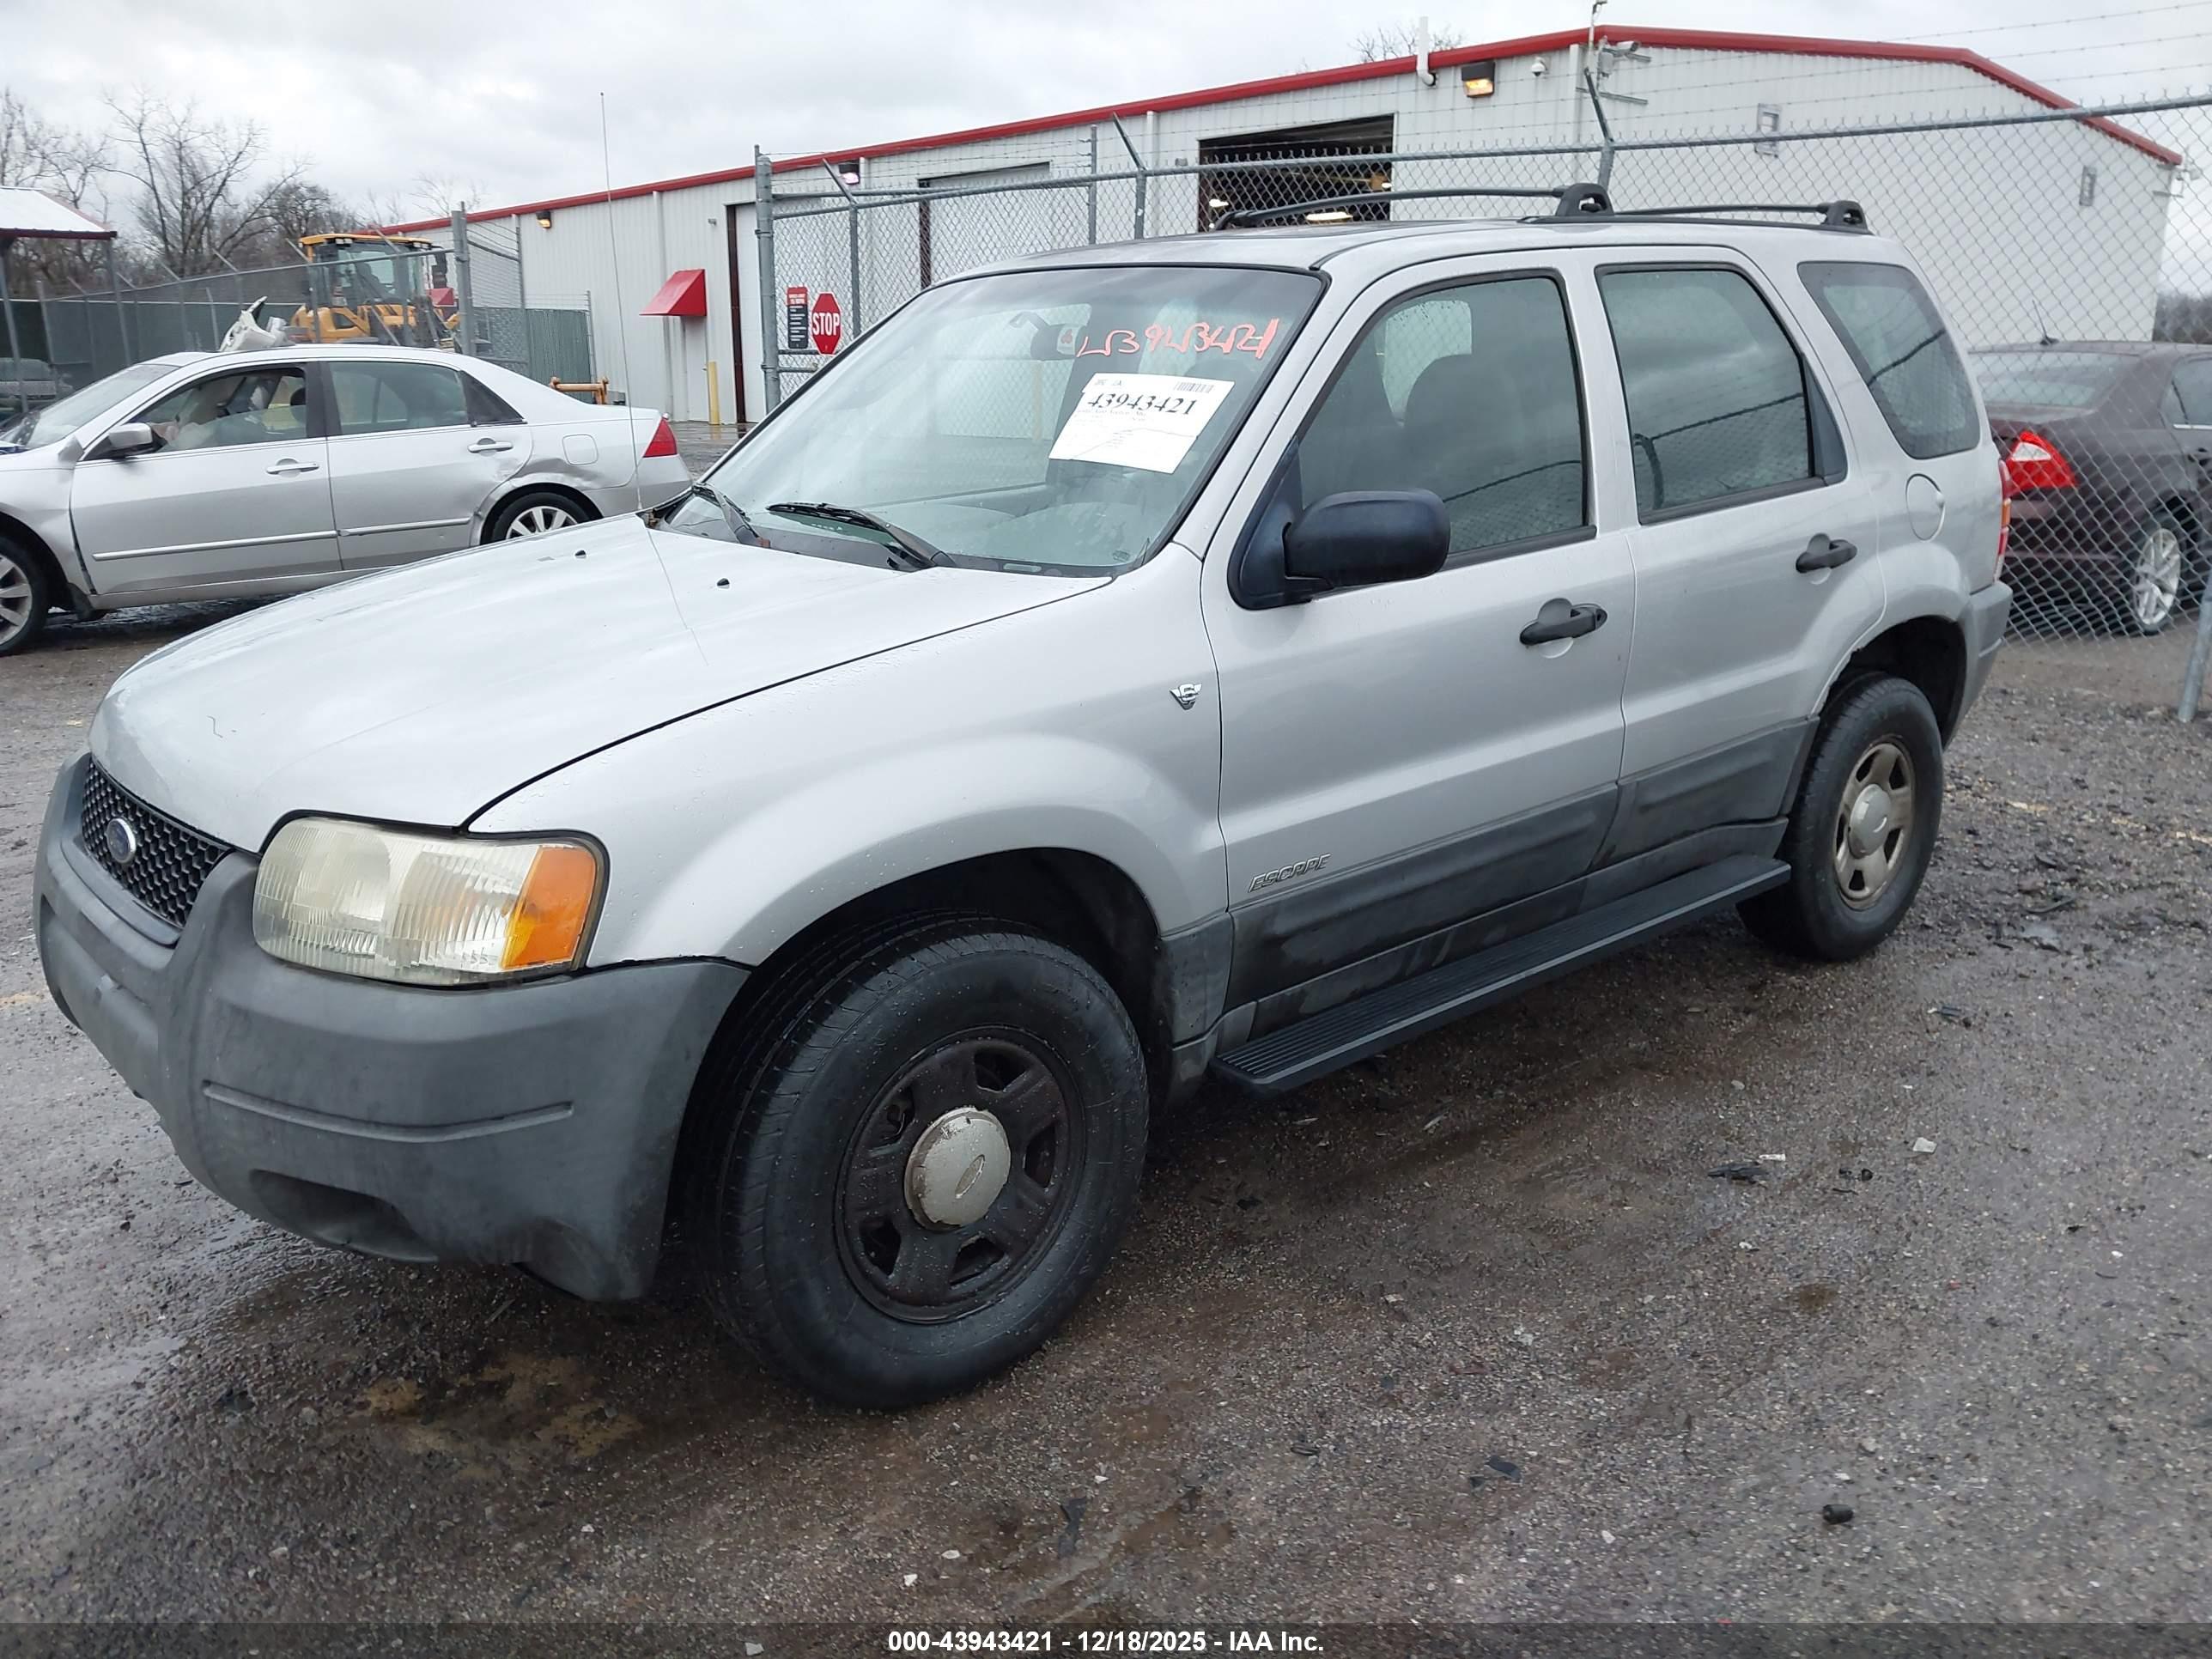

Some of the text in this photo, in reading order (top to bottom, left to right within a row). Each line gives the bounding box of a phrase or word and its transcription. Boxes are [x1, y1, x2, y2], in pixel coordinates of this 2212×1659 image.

[812, 312, 840, 336] STOP
[1087, 392, 1199, 416] 43943421
[1248, 853, 1332, 893] ESCAPE
